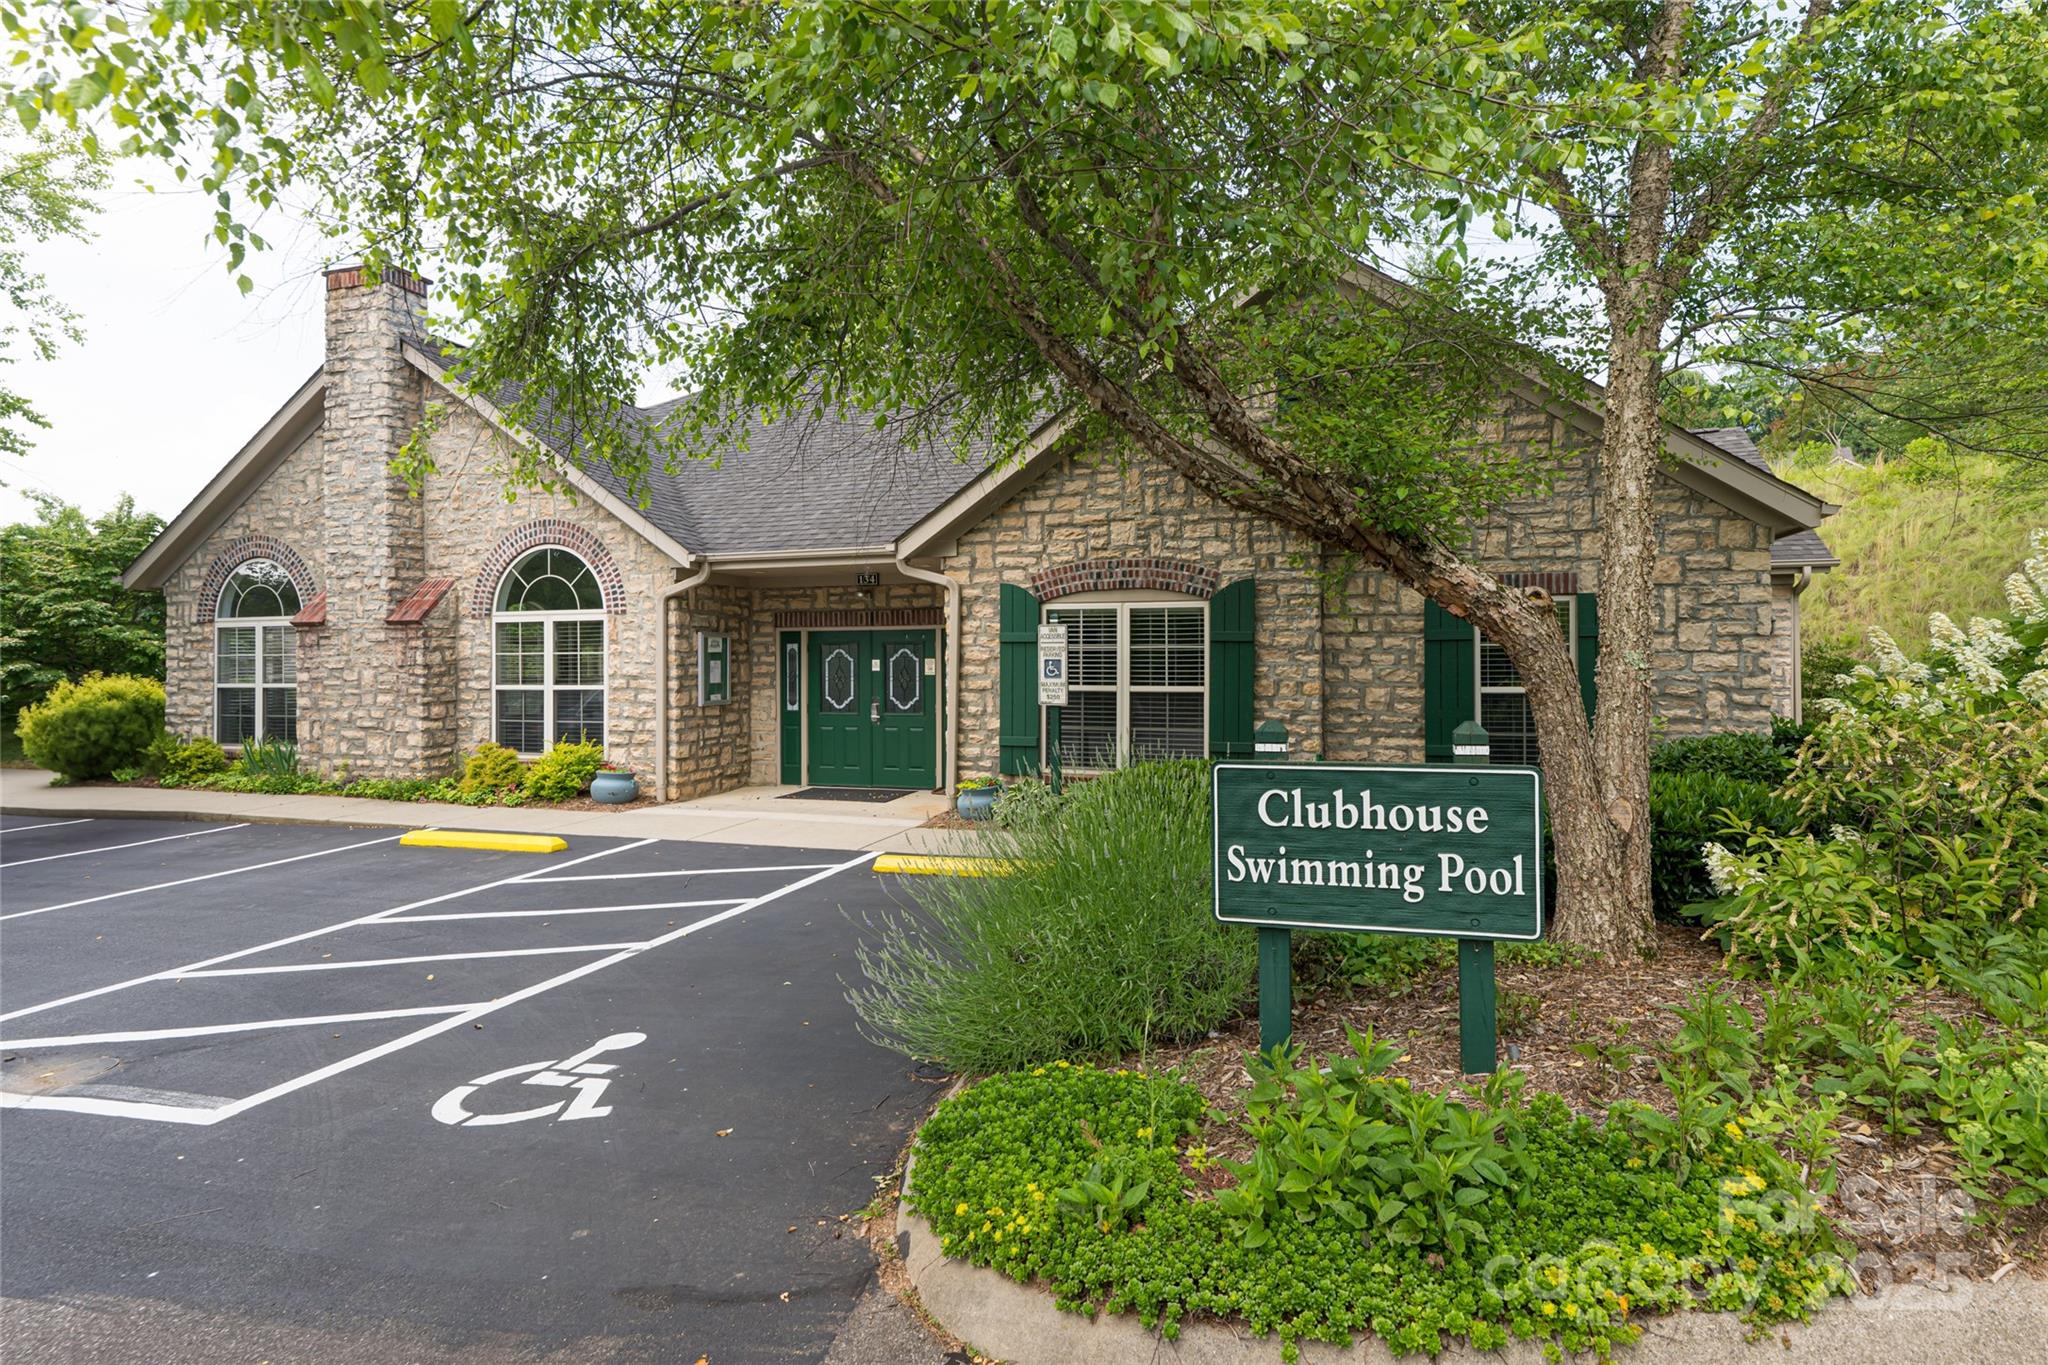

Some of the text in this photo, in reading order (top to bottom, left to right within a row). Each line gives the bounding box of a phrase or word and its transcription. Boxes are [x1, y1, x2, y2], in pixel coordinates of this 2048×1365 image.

[1257, 788, 1489, 834] Clubhouse
[1227, 844, 1526, 903] Swimming Pool
